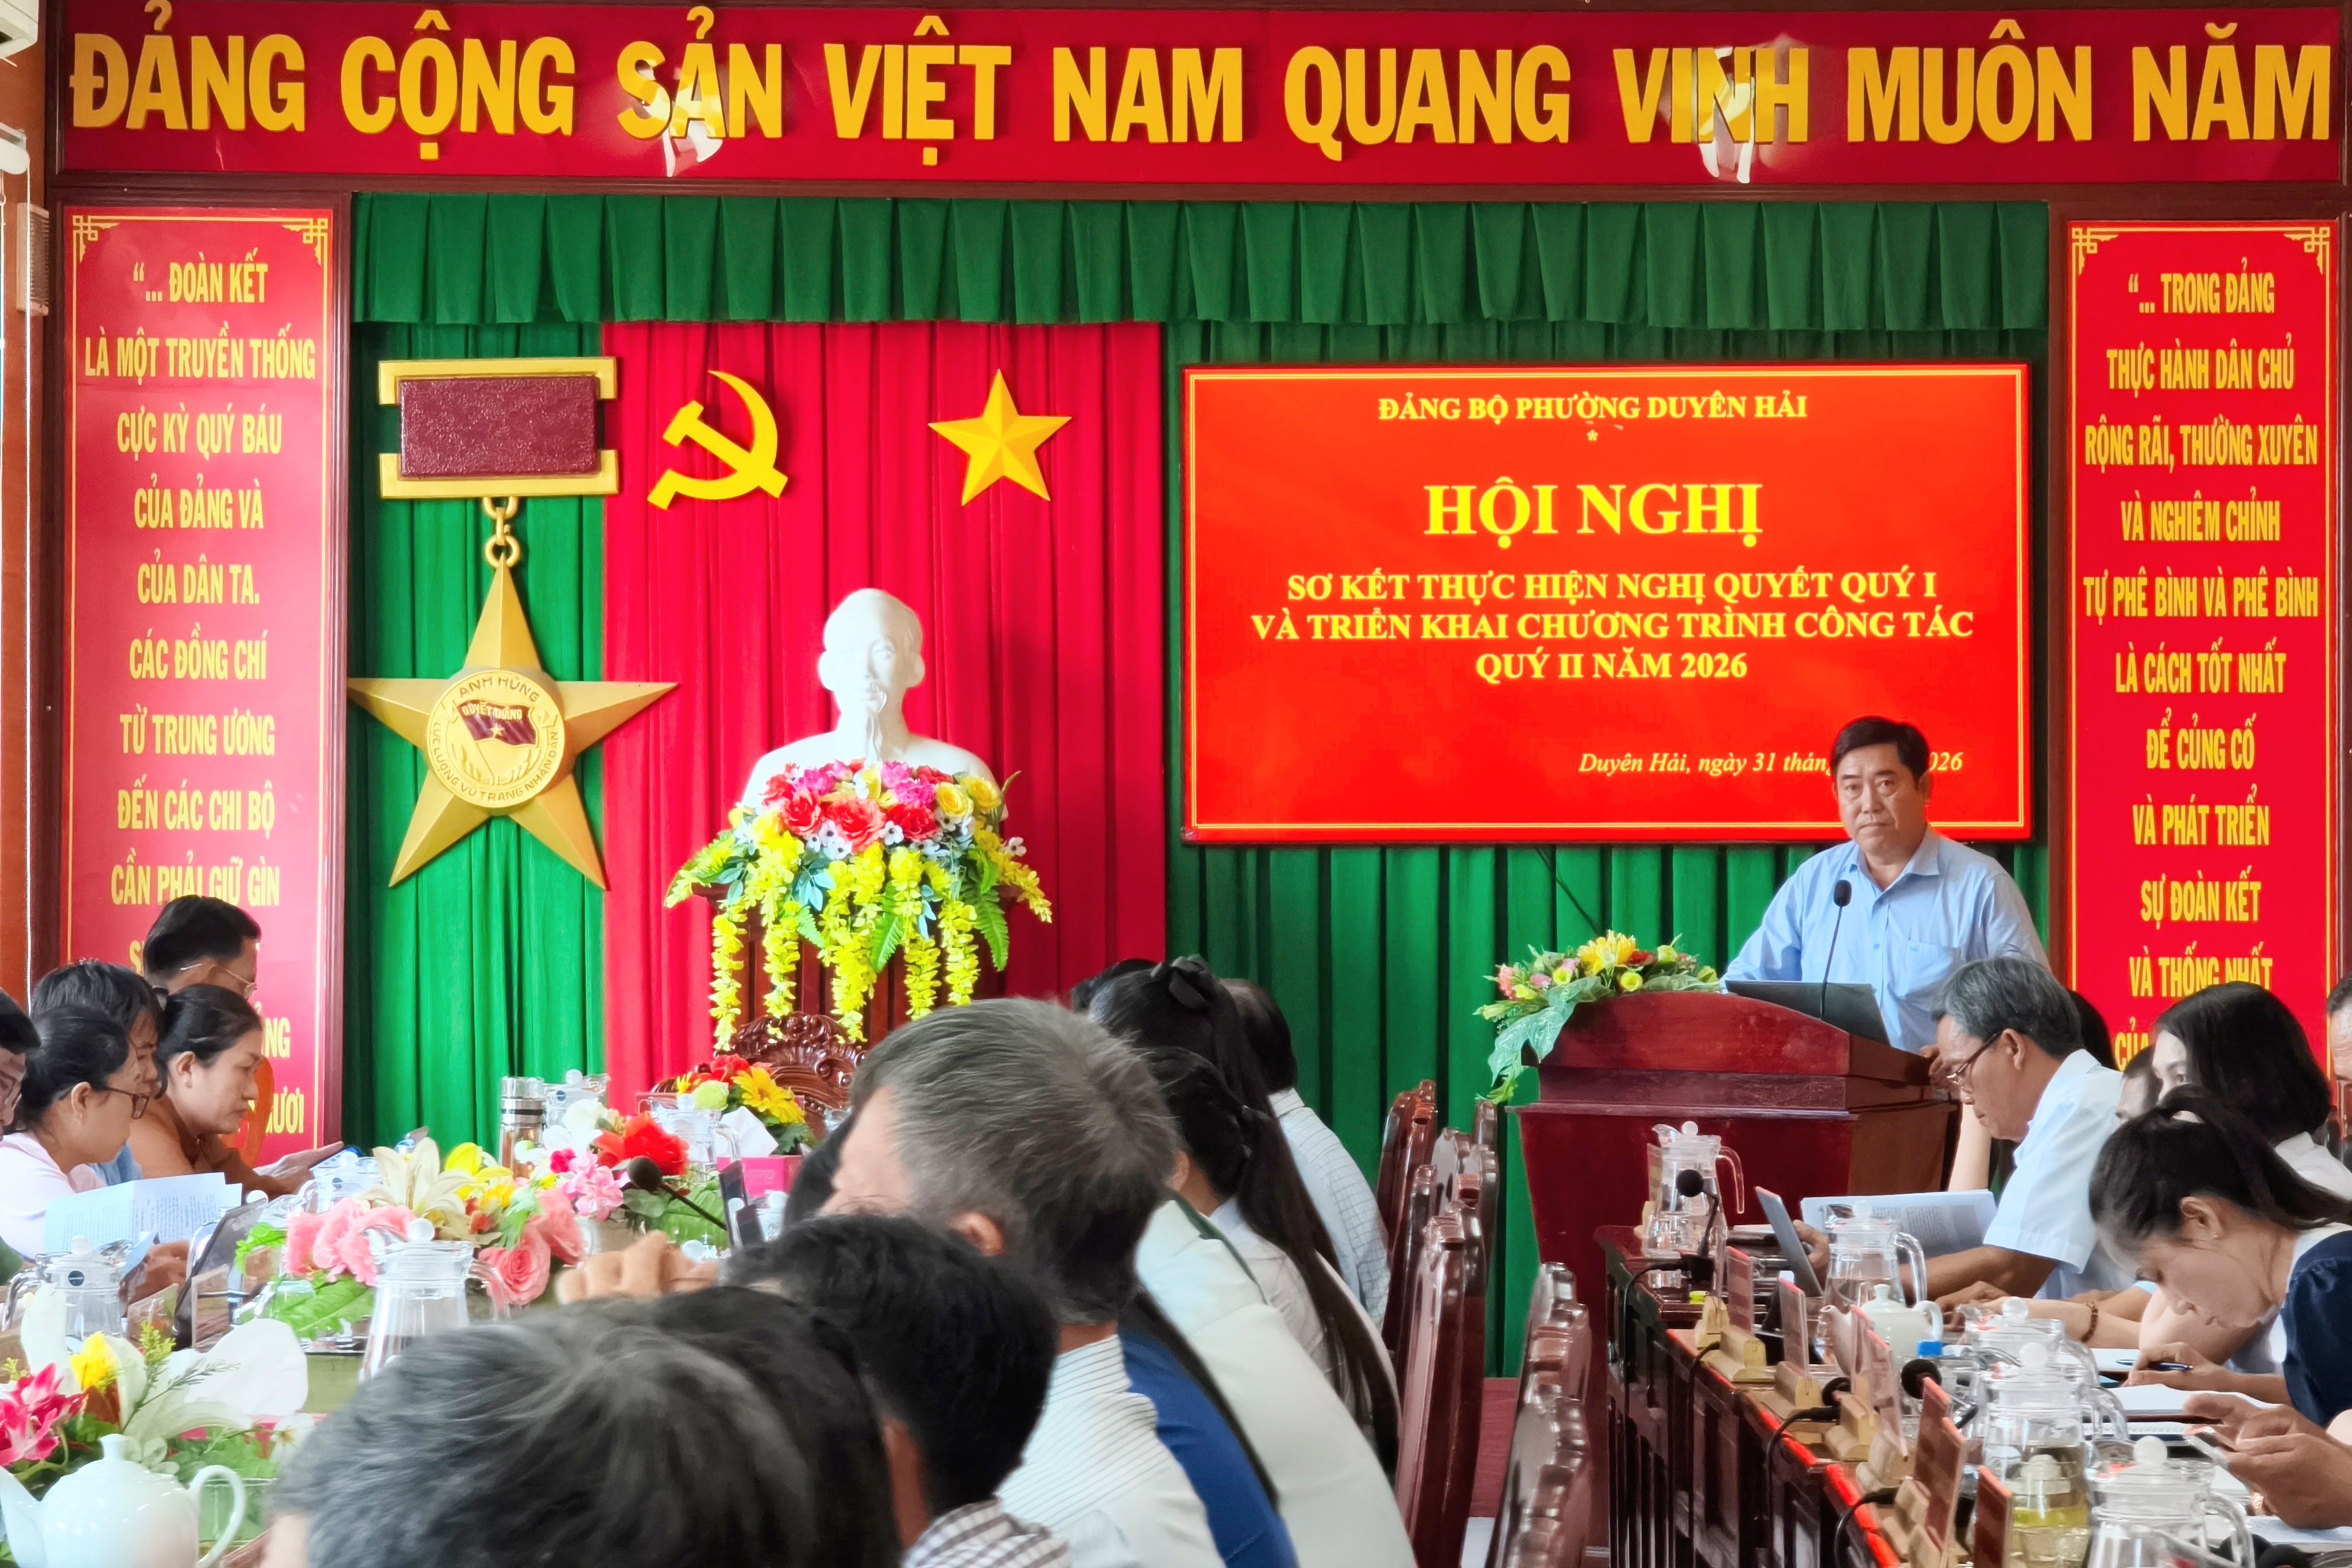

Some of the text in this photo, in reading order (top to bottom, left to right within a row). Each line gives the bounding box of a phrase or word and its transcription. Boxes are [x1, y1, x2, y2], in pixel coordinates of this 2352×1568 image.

[70, 0, 2331, 166] ĐẢNG CỘNG SẢN VIỆT NAM QUANG VINH MUÔN NĂM
[169, 250, 223, 303] ĐOÀN
[229, 247, 268, 303] KẾT
[2160, 273, 2220, 313] TRONG
[2225, 256, 2274, 313] ĐẢNG
[85, 321, 316, 385] LÀ MỘT TRUYỀN THỐNG
[2106, 332, 2295, 398] THỰC HÀNH DÂN CHỦ
[117, 402, 282, 461] CỰC KỲ QUÝ BÁU
[1378, 389, 1808, 425] ĐẢNG BỘ PHƯỜNG DUYÊN HẢI
[2085, 413, 2318, 474] RỘNG RÃI, THƯỜNG XUYÊN
[134, 473, 264, 529] CỦA ĐẢNG VÀ
[1423, 476, 1763, 549] HỘI NGHỊ
[2121, 486, 2280, 541] VÀ NGHIÊM CHỈNH
[137, 548, 260, 604] CỦA DÂN TA.
[1288, 565, 1937, 606] SƠ KẾT THỰC HIỆN NGHỊ QUYẾT QUÝ I
[2083, 566, 2318, 625] TỰ PHÊ BÌNH VÀ PHÊ BÌNH
[129, 622, 268, 680] CÁC ĐỒNG CHÍ
[1251, 607, 1300, 640] VÀ
[1420, 614, 1509, 640] KHAI
[1517, 609, 1670, 639] CHƯƠNG
[1677, 605, 1787, 638] TRÌNH
[1794, 605, 1895, 638] CÔNG
[1902, 605, 1974, 637] TÁC
[459, 676, 493, 698] ANH
[1476, 645, 1747, 684] QUÝ II NĂM 2026
[2115, 637, 2287, 693] LÀ CÁCH TỐT NHẤT
[119, 703, 275, 756] TỪ TRUNG ƯƠNG
[2146, 707, 2257, 770] ĐỂ CỦNG CỐ
[1578, 752, 1643, 776] Duyên
[1648, 752, 1690, 774] Hải,
[1698, 752, 1747, 776] ngày
[1752, 752, 1776, 772] 31
[1929, 752, 1964, 771] 026
[117, 773, 274, 839] ĐẾN CÁC CHI BỘ
[481, 788, 524, 802] TRANG
[2133, 783, 2269, 845] VÀ PHÁT TRIỂN
[111, 847, 280, 906] CẦN PHẢI GIỮ GÌN
[2141, 865, 2261, 930] SỰ ĐOÀN KẾT
[129, 940, 145, 977] S
[2129, 940, 2273, 997] VÀ THỐNG NHẤT
